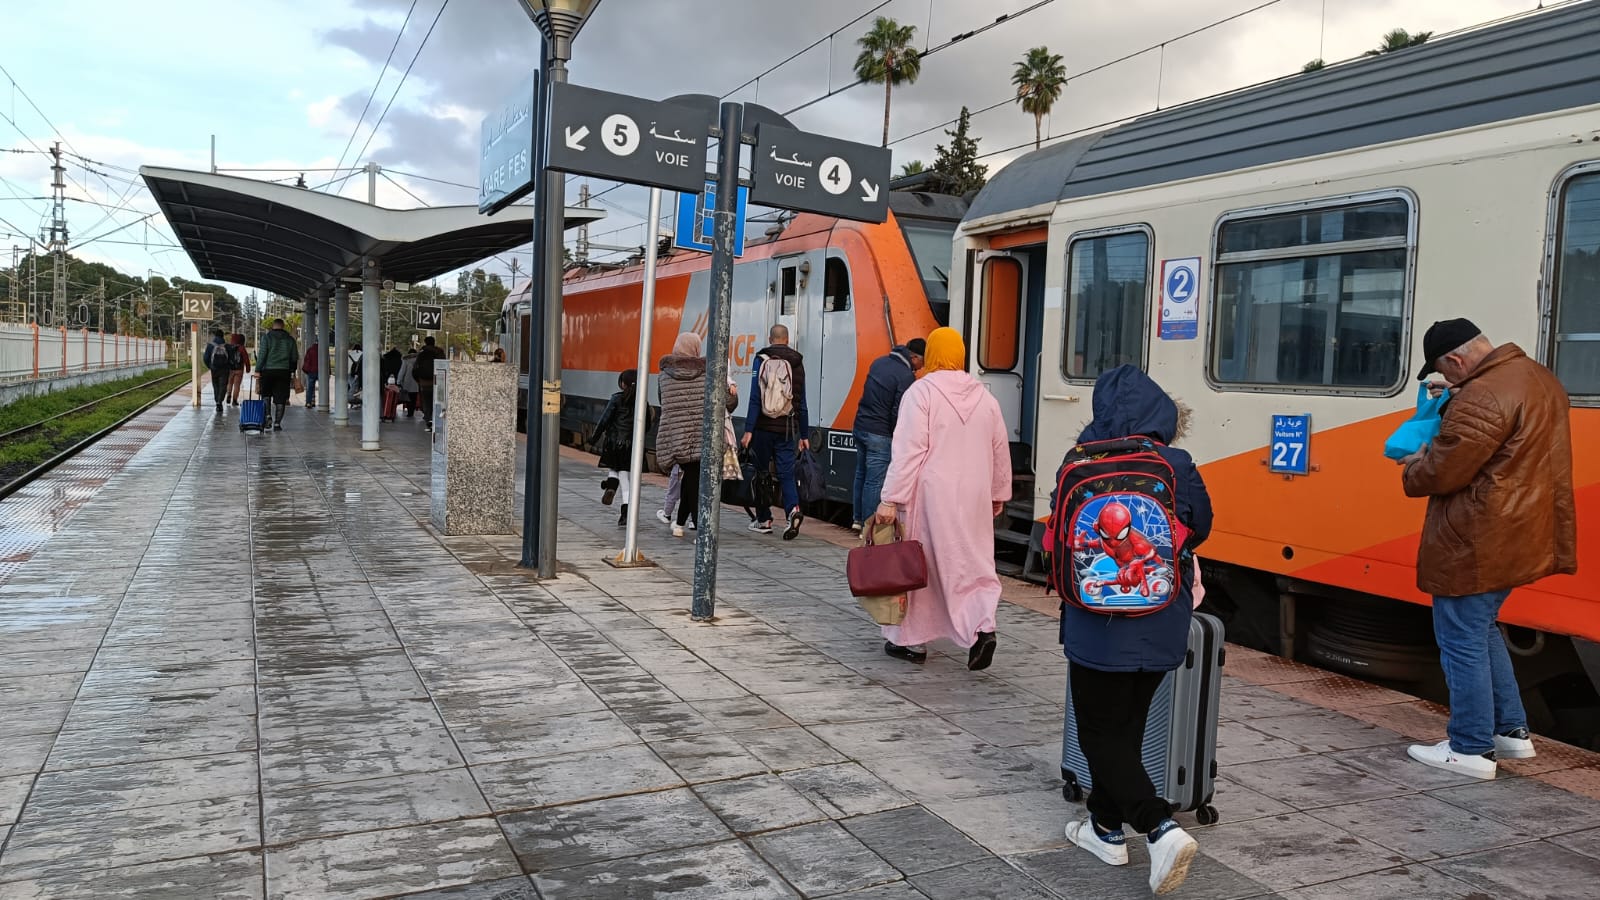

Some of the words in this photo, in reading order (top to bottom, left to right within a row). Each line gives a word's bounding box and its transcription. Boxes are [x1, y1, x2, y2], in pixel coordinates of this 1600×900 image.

[613, 124, 628, 147] 5
[649, 121, 697, 145] سكة
[508, 148, 527, 180] FES
[655, 150, 689, 167] VOIE
[769, 145, 813, 168] سكة
[775, 172, 806, 189] VOIE
[828, 165, 840, 184] 4
[1173, 270, 1188, 297] 2
[185, 299, 211, 313] 12V
[418, 311, 440, 325] 12V
[831, 436, 857, 447] E-140
[1273, 441, 1304, 467] 27
